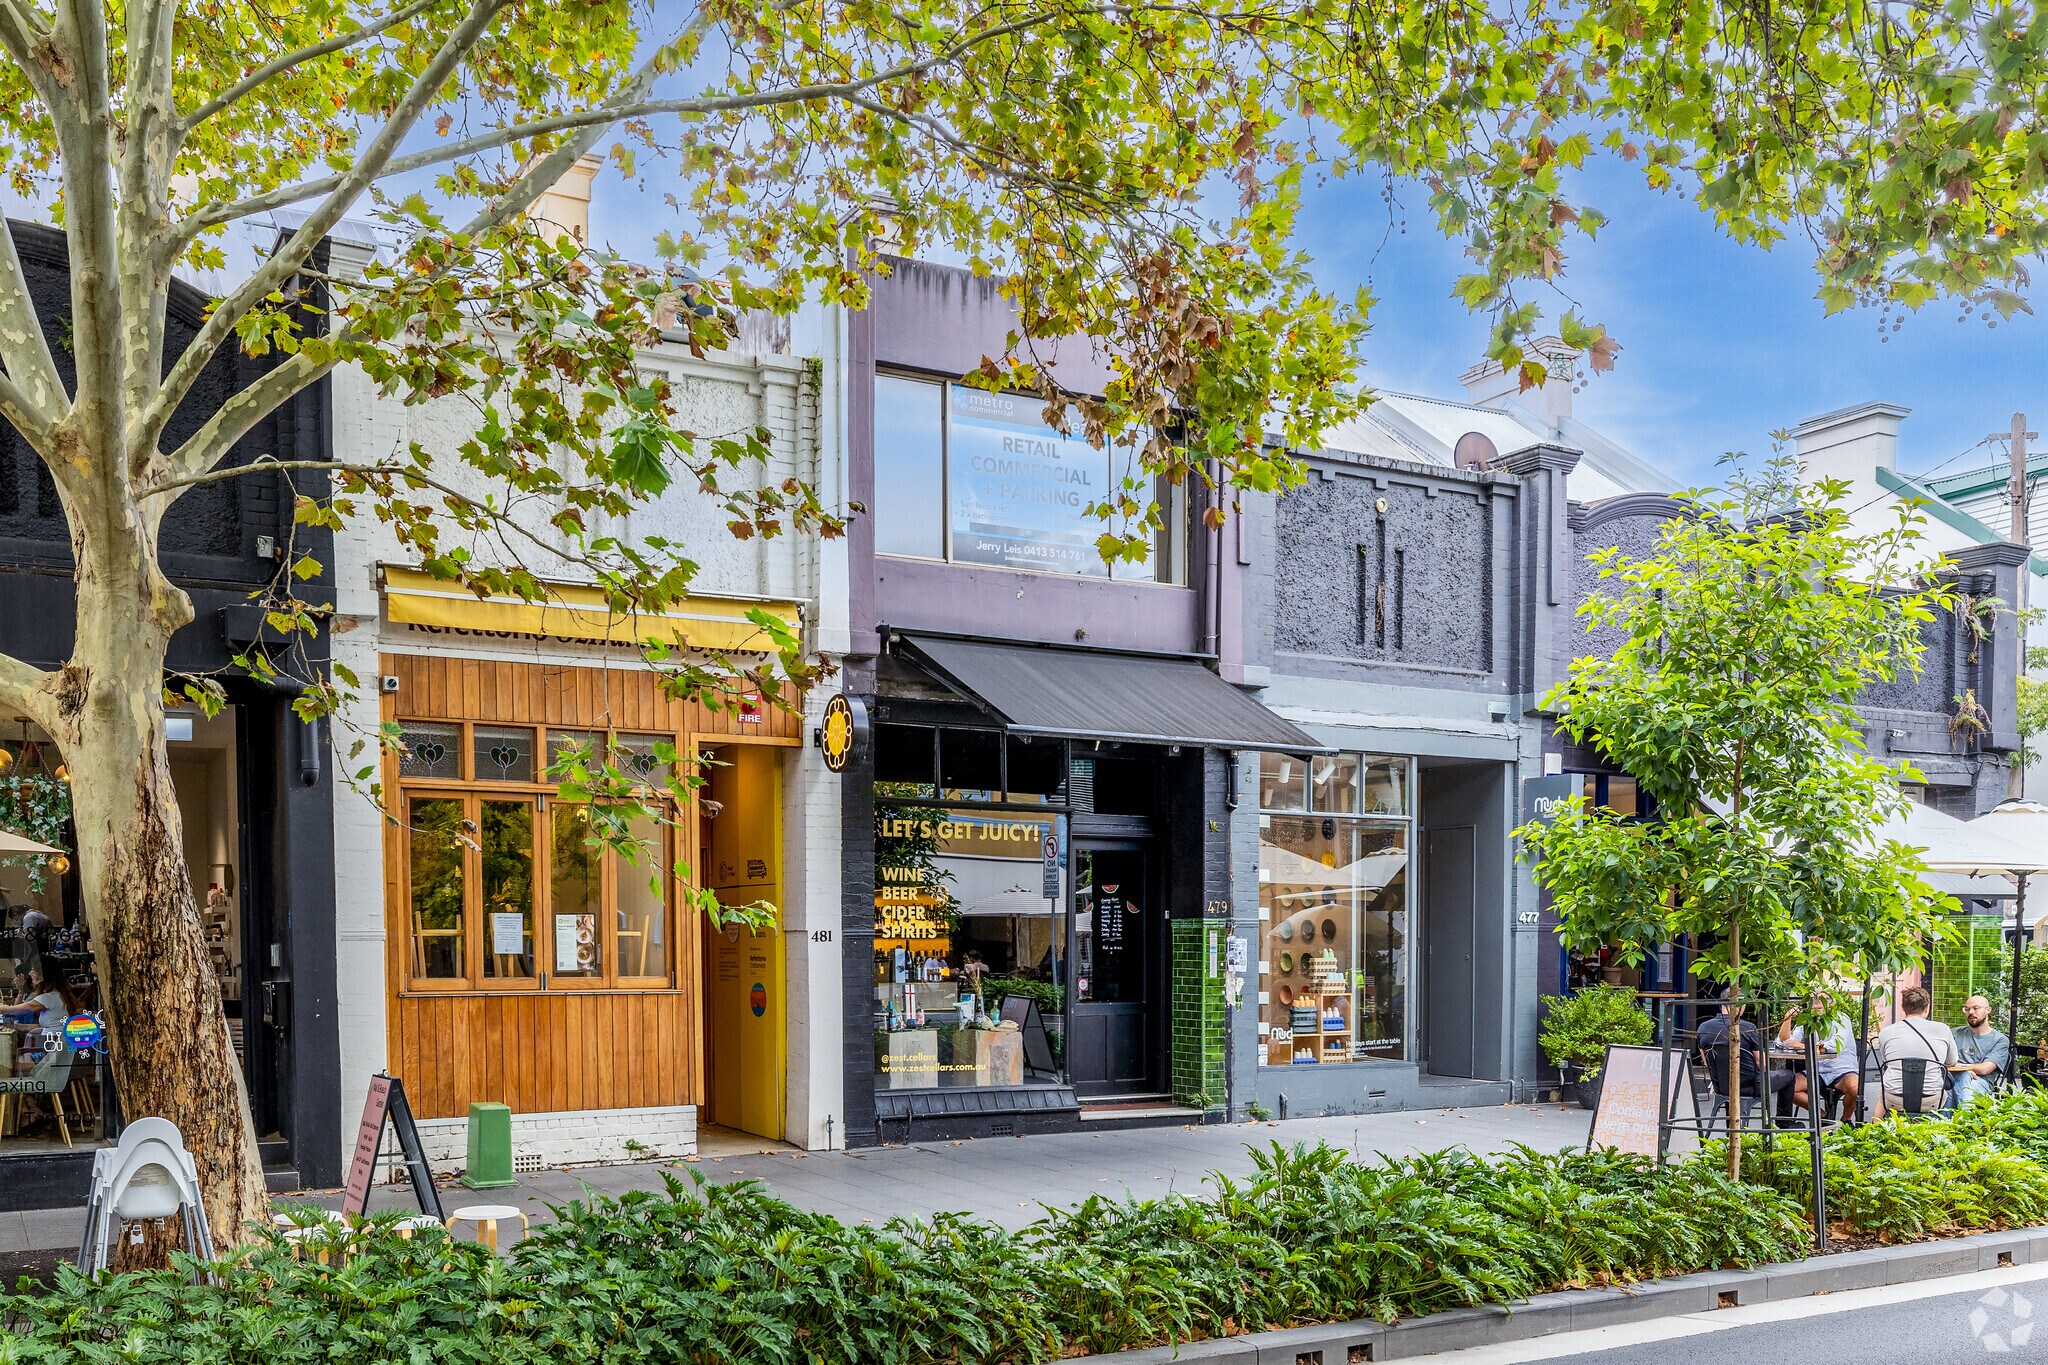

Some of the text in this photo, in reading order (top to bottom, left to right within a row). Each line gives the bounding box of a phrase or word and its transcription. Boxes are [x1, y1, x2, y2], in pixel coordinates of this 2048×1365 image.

[970, 394, 1013, 410] metro
[970, 406, 1014, 416] commercial
[1003, 436, 1060, 459] RETAIL
[971, 456, 1091, 486] COMMERCIAL
[1001, 483, 1080, 506] PARKING
[976, 540, 1086, 561] Jerry Leis 0413 514 761
[739, 714, 761, 723] FIRE
[882, 820, 1039, 843] LET'S GET JUICY!
[882, 867, 925, 882] WINE
[882, 886, 918, 900] BEER
[882, 906, 925, 920] CIDER
[1208, 901, 1227, 914] 479
[1518, 912, 1539, 923] 477
[811, 930, 832, 942] 481
[882, 925, 937, 939] SPIRITS
[881, 1052, 936, 1063] @zest.cellars
[881, 1063, 986, 1073] www.zestcellars.com.au
[0, 1078, 45, 1094] axing
[1609, 1102, 1655, 1118] Come in
[1601, 1120, 1655, 1134] we're ope
